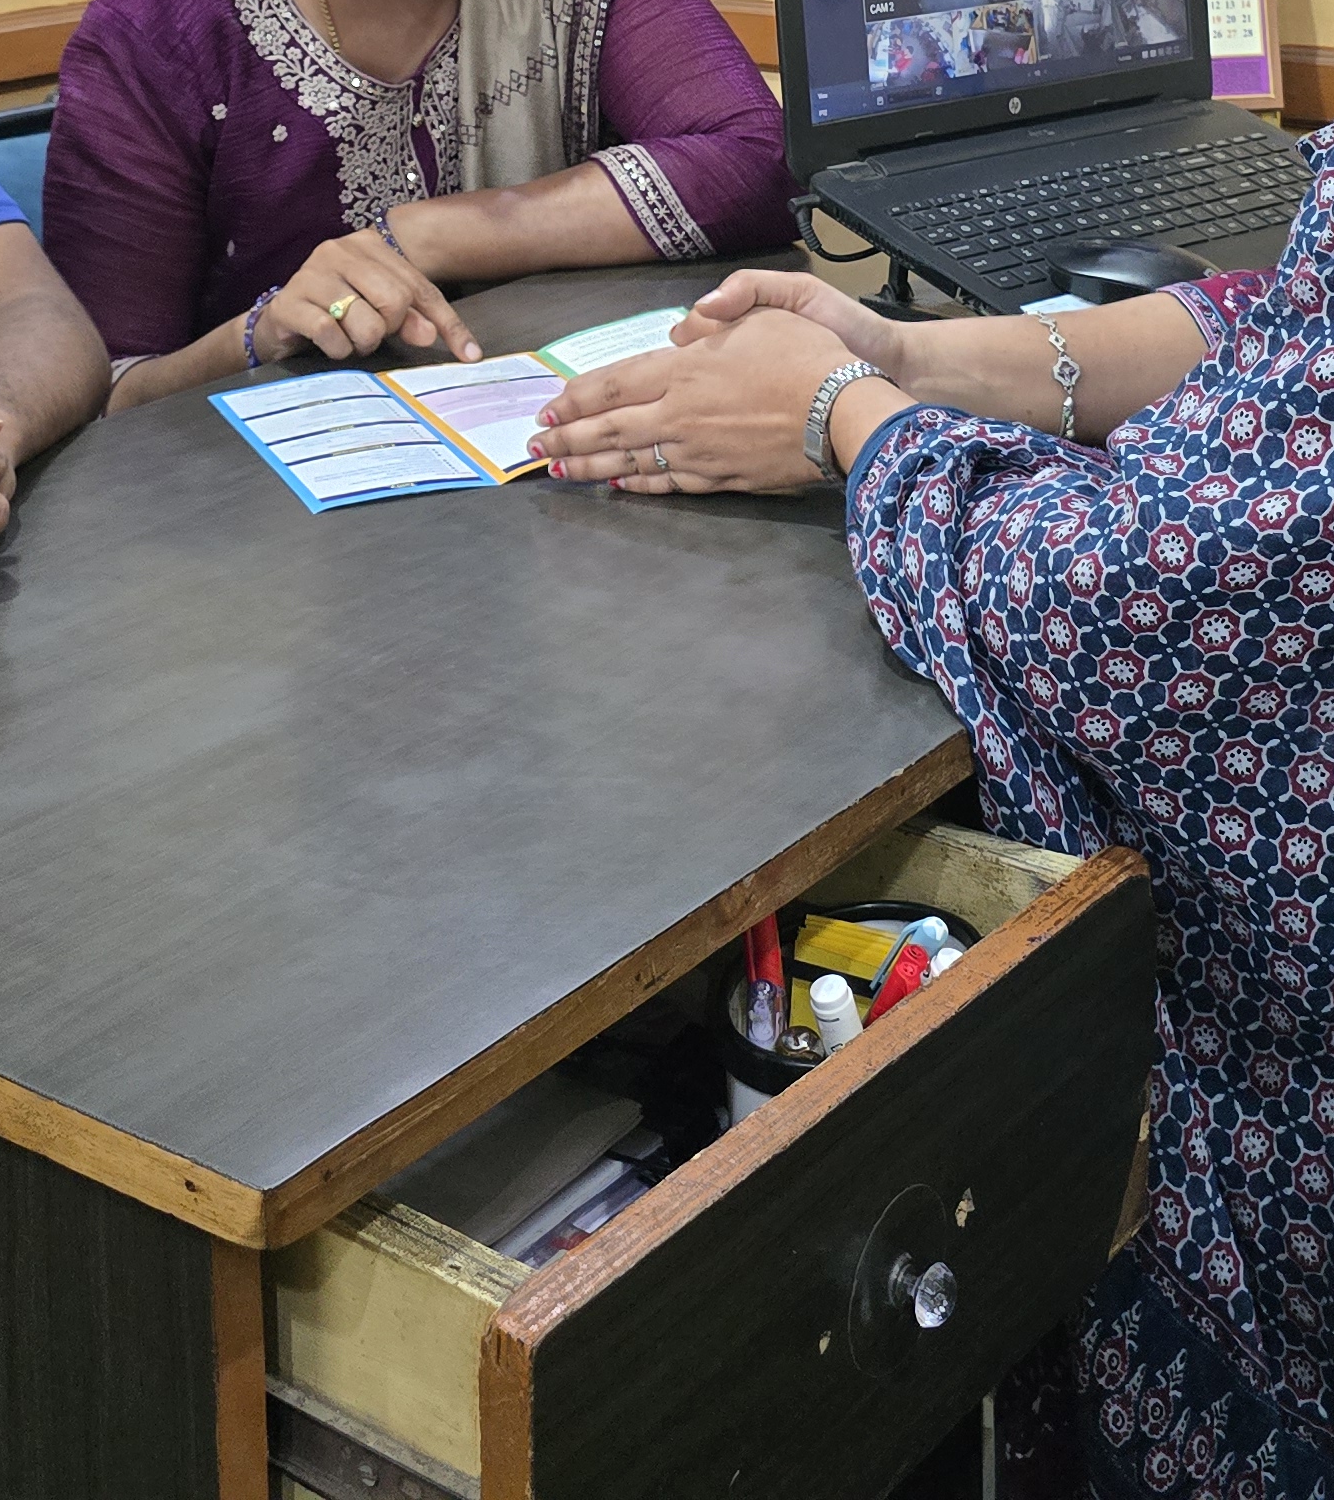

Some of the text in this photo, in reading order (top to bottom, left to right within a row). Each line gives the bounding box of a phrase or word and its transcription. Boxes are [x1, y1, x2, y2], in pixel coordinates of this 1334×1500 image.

[869, 1, 895, 15] CAM 2
[1211, 0, 1251, 10] 12 13 14
[1212, 14, 1251, 25] 19 20 21
[1212, 29, 1253, 39] 26 27 28
